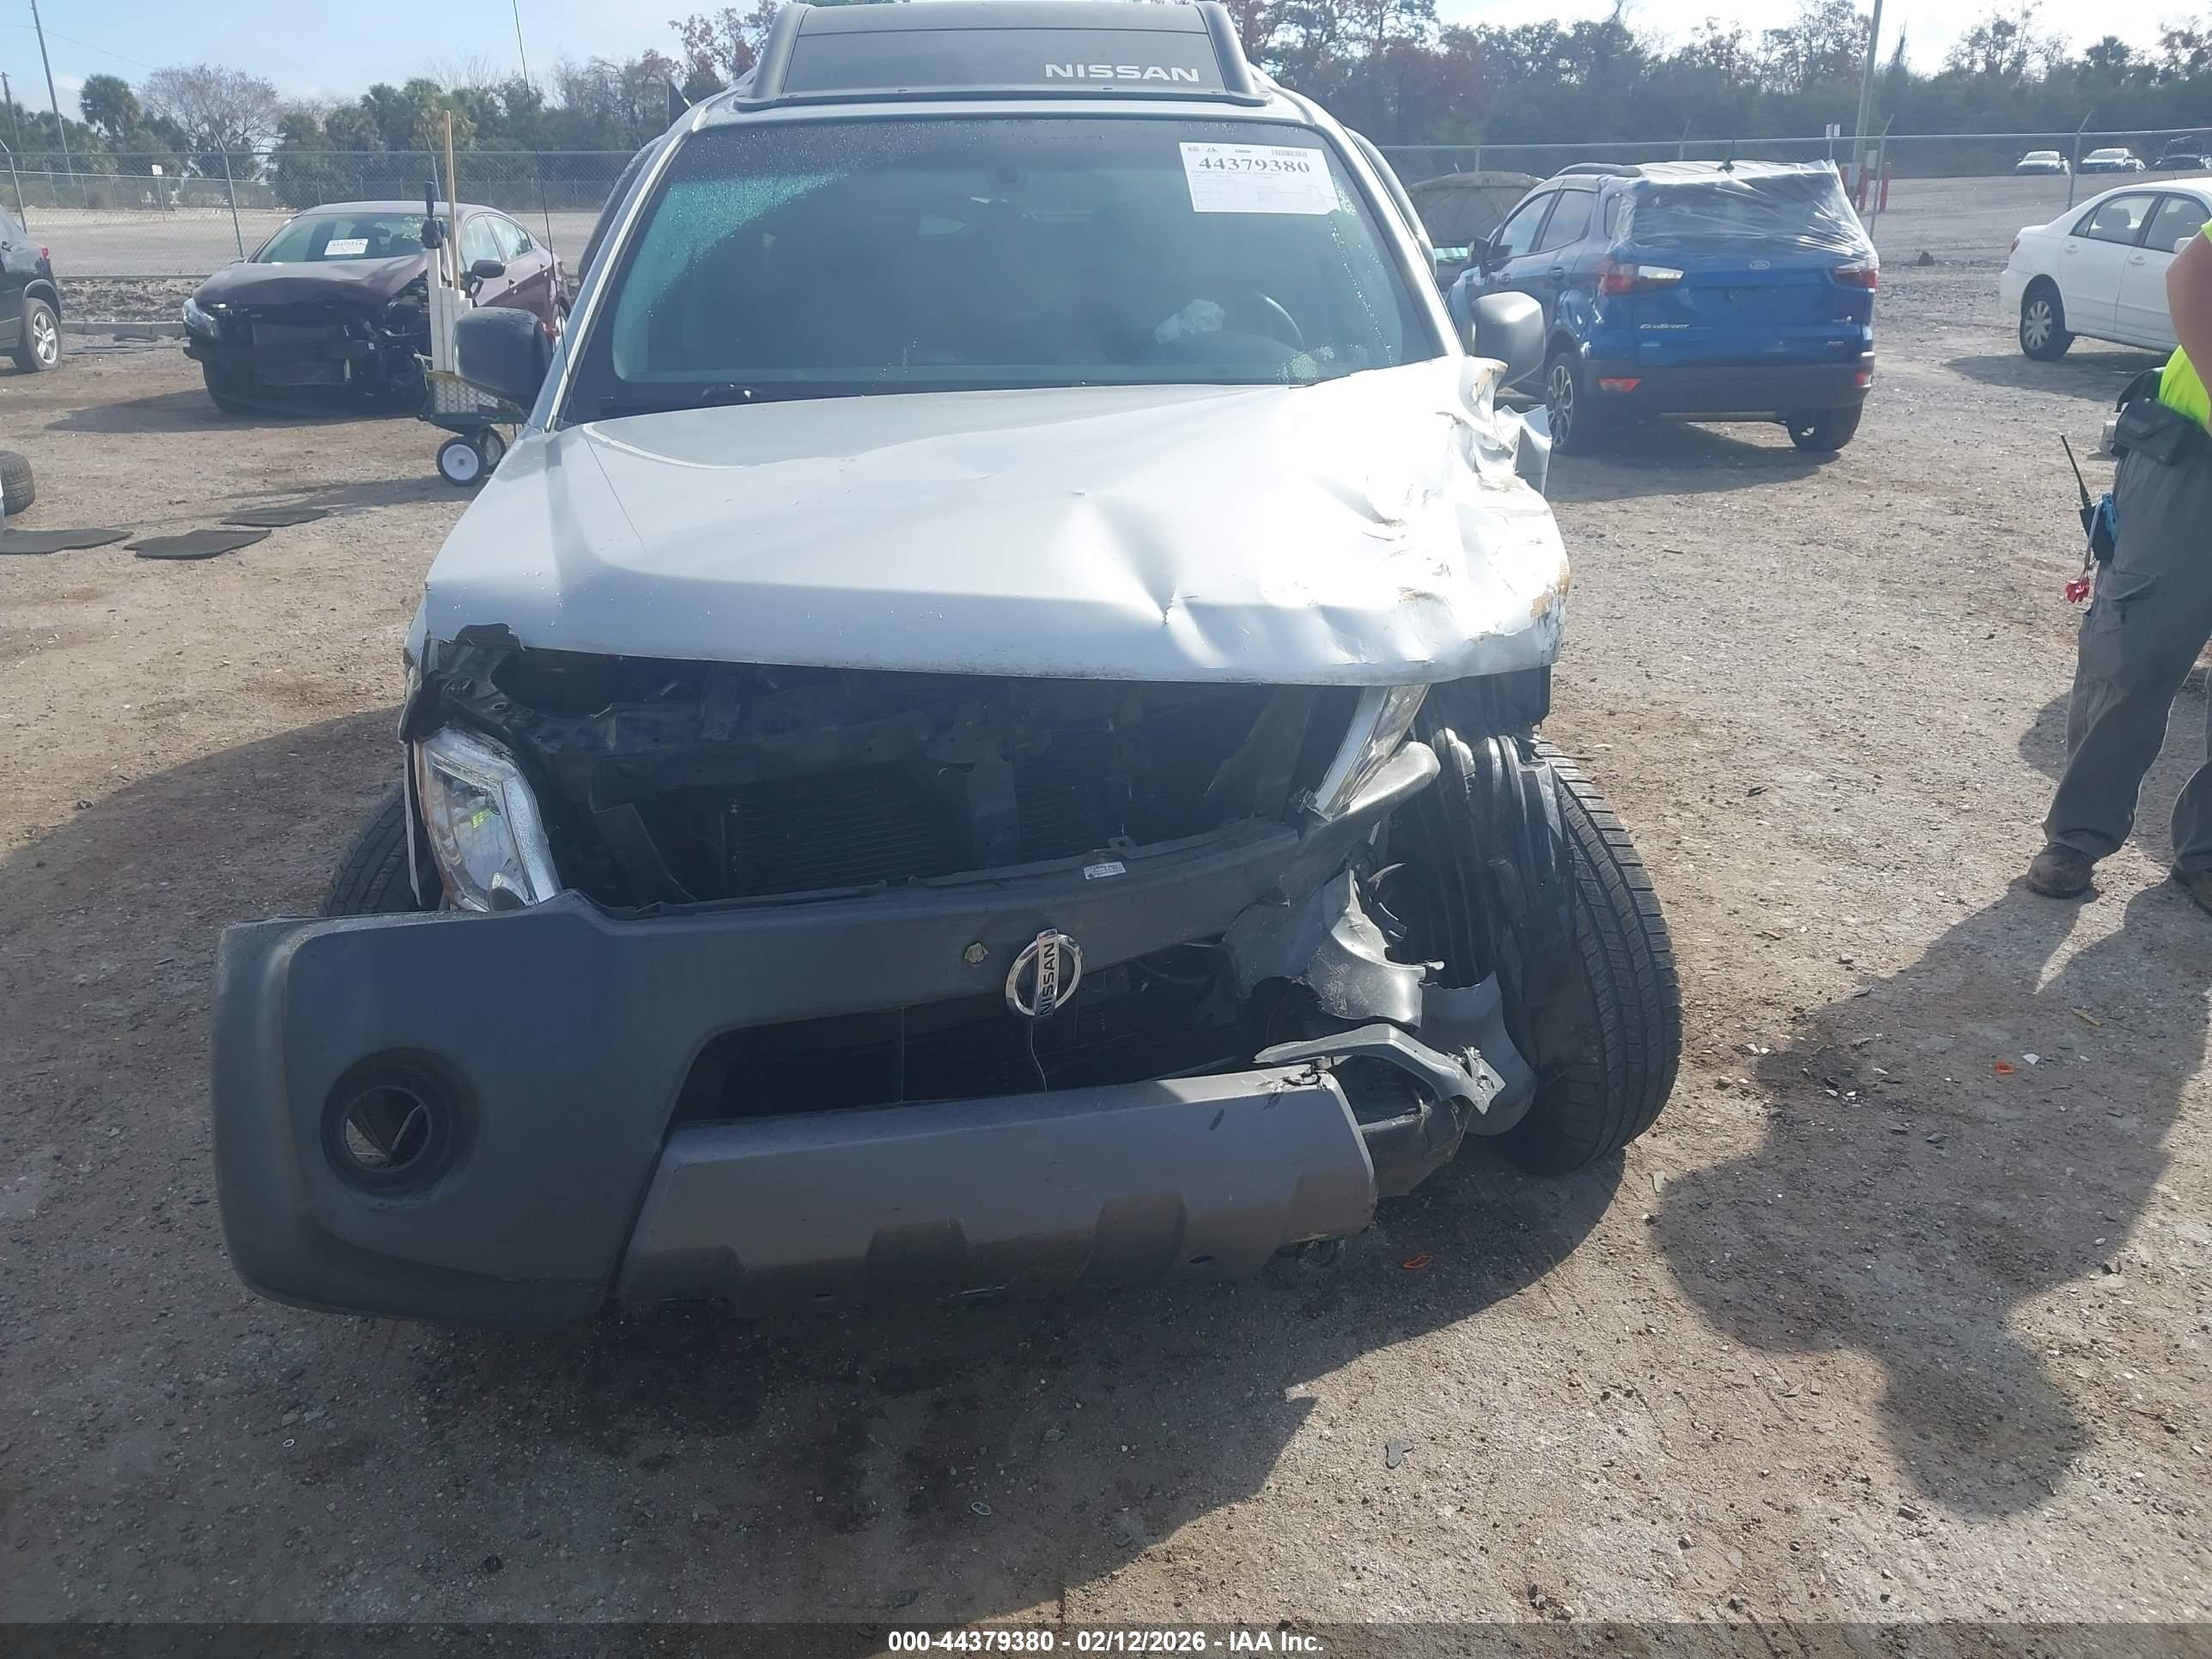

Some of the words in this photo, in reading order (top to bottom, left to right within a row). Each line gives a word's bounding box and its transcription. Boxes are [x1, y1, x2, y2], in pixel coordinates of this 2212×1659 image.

[1045, 64, 1200, 82] NISSAN
[1199, 157, 1310, 173] 44379380
[1041, 942, 1055, 1016] NISSAN
